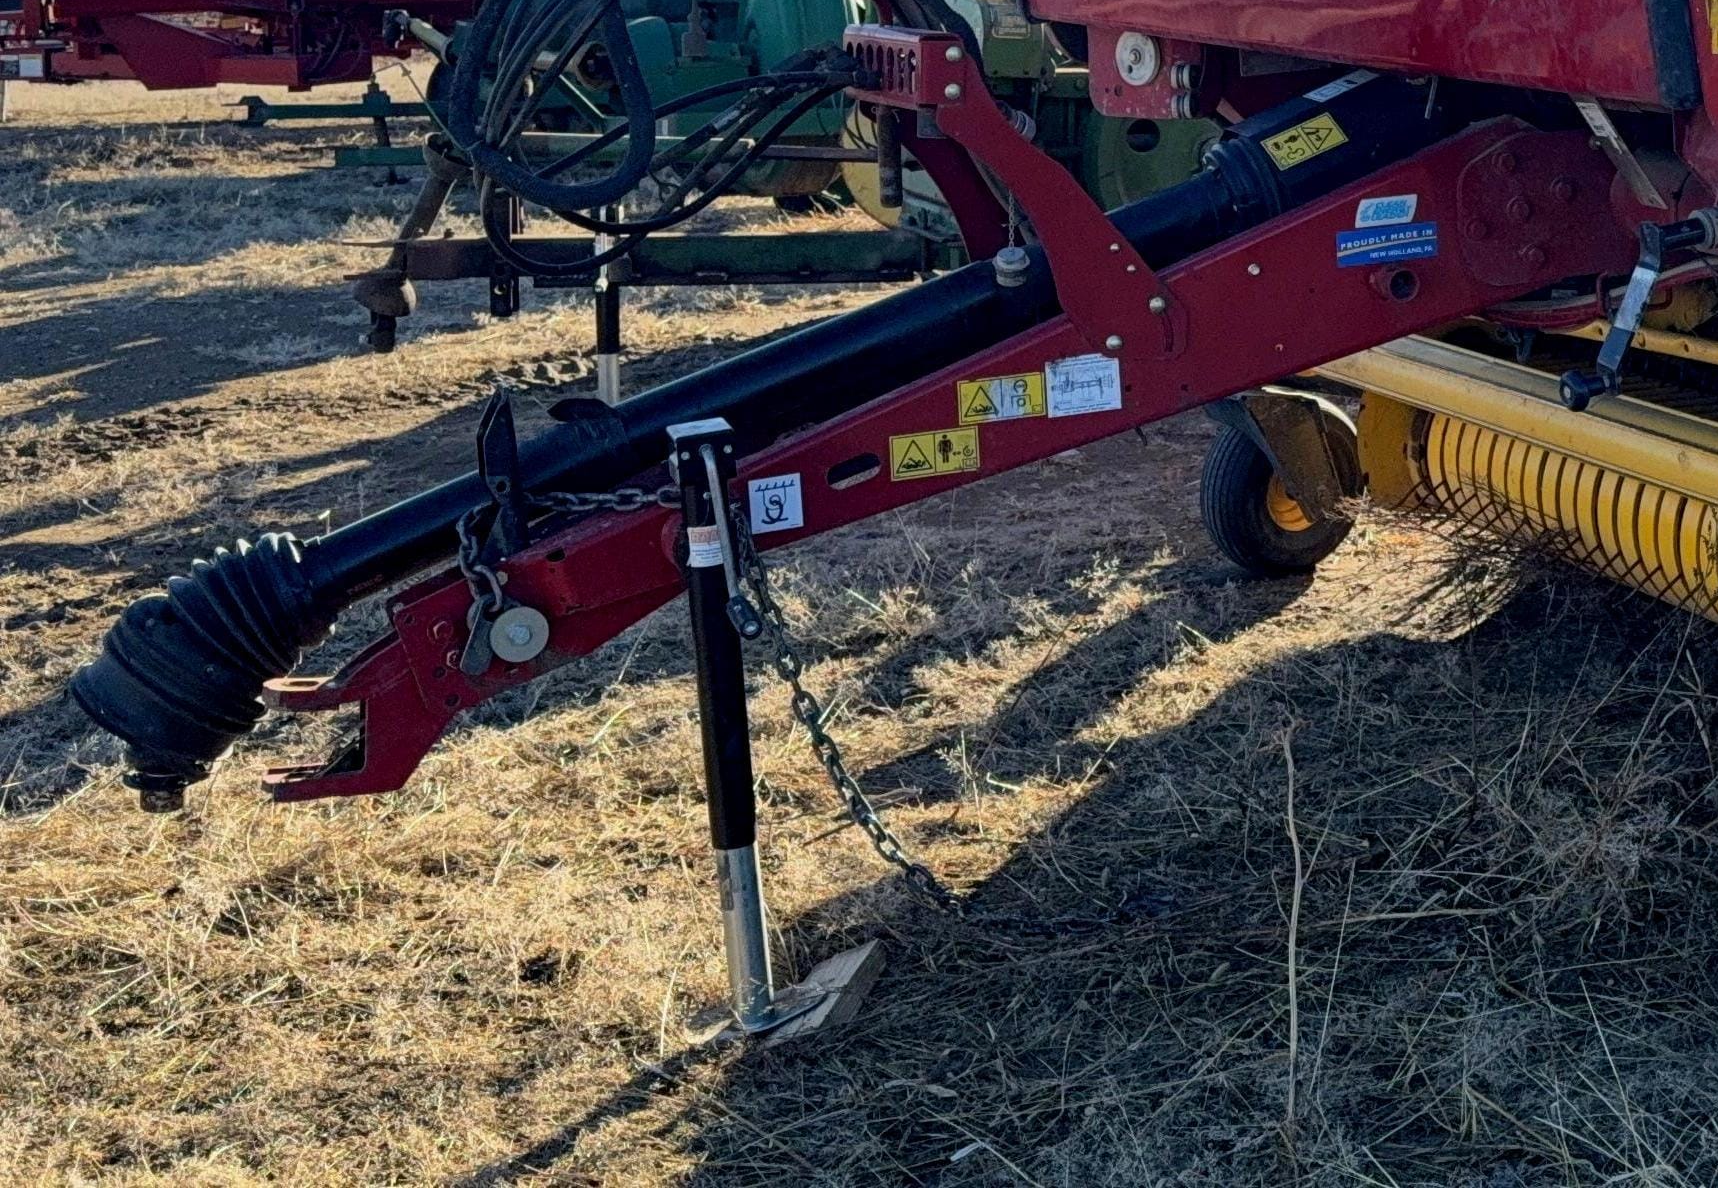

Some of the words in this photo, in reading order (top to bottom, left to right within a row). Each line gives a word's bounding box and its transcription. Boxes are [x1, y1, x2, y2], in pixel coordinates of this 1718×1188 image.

[1341, 235, 1386, 250] PROUDLY
[1390, 230, 1418, 241] MADE
[1422, 229, 1433, 237] IN
[1370, 250, 1387, 259] NEW
